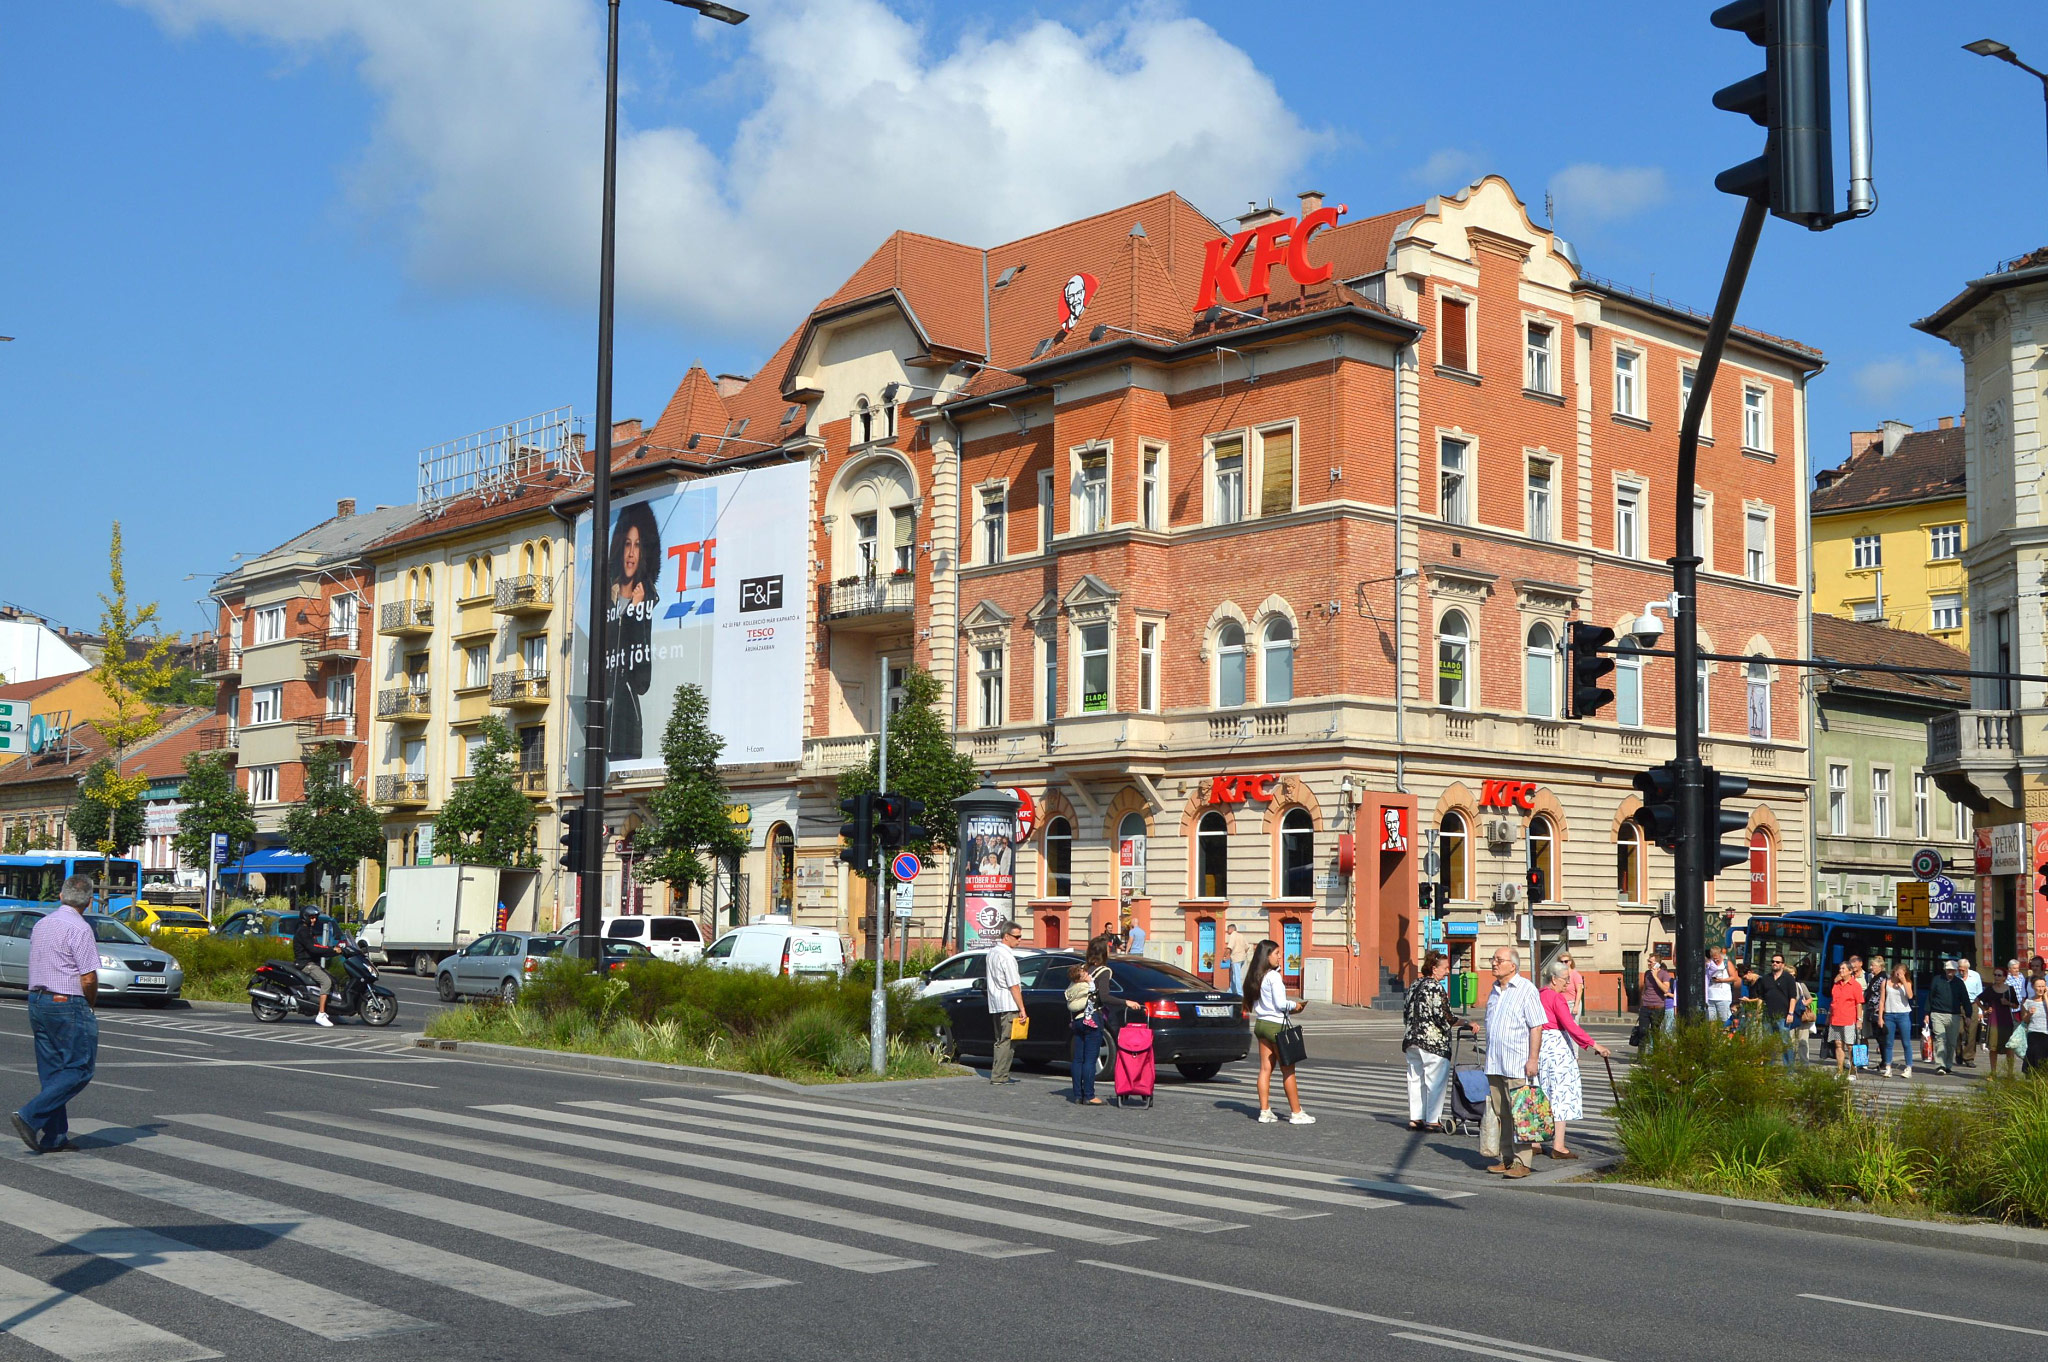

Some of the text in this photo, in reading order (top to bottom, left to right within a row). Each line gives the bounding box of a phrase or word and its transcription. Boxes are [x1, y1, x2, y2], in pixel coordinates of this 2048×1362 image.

[1193, 207, 1338, 312] KFC
[668, 538, 716, 592] TE
[742, 579, 780, 609] F&F
[626, 599, 654, 621] egy
[747, 627, 775, 638] TESCO
[629, 643, 684, 671] jöttem
[745, 644, 775, 652] ÁRUHÁZAKBAN
[1440, 660, 1461, 669] ELADÓ
[1085, 691, 1107, 702] ELADÓ
[1208, 774, 1274, 803] KFC
[1479, 779, 1537, 809] KFC
[967, 822, 1013, 842] NEOTON
[1995, 829, 2019, 853] PETRÓ
[965, 875, 989, 884] OKTÓBER
[1750, 872, 1765, 882] KFC
[1940, 902, 1959, 913] One
